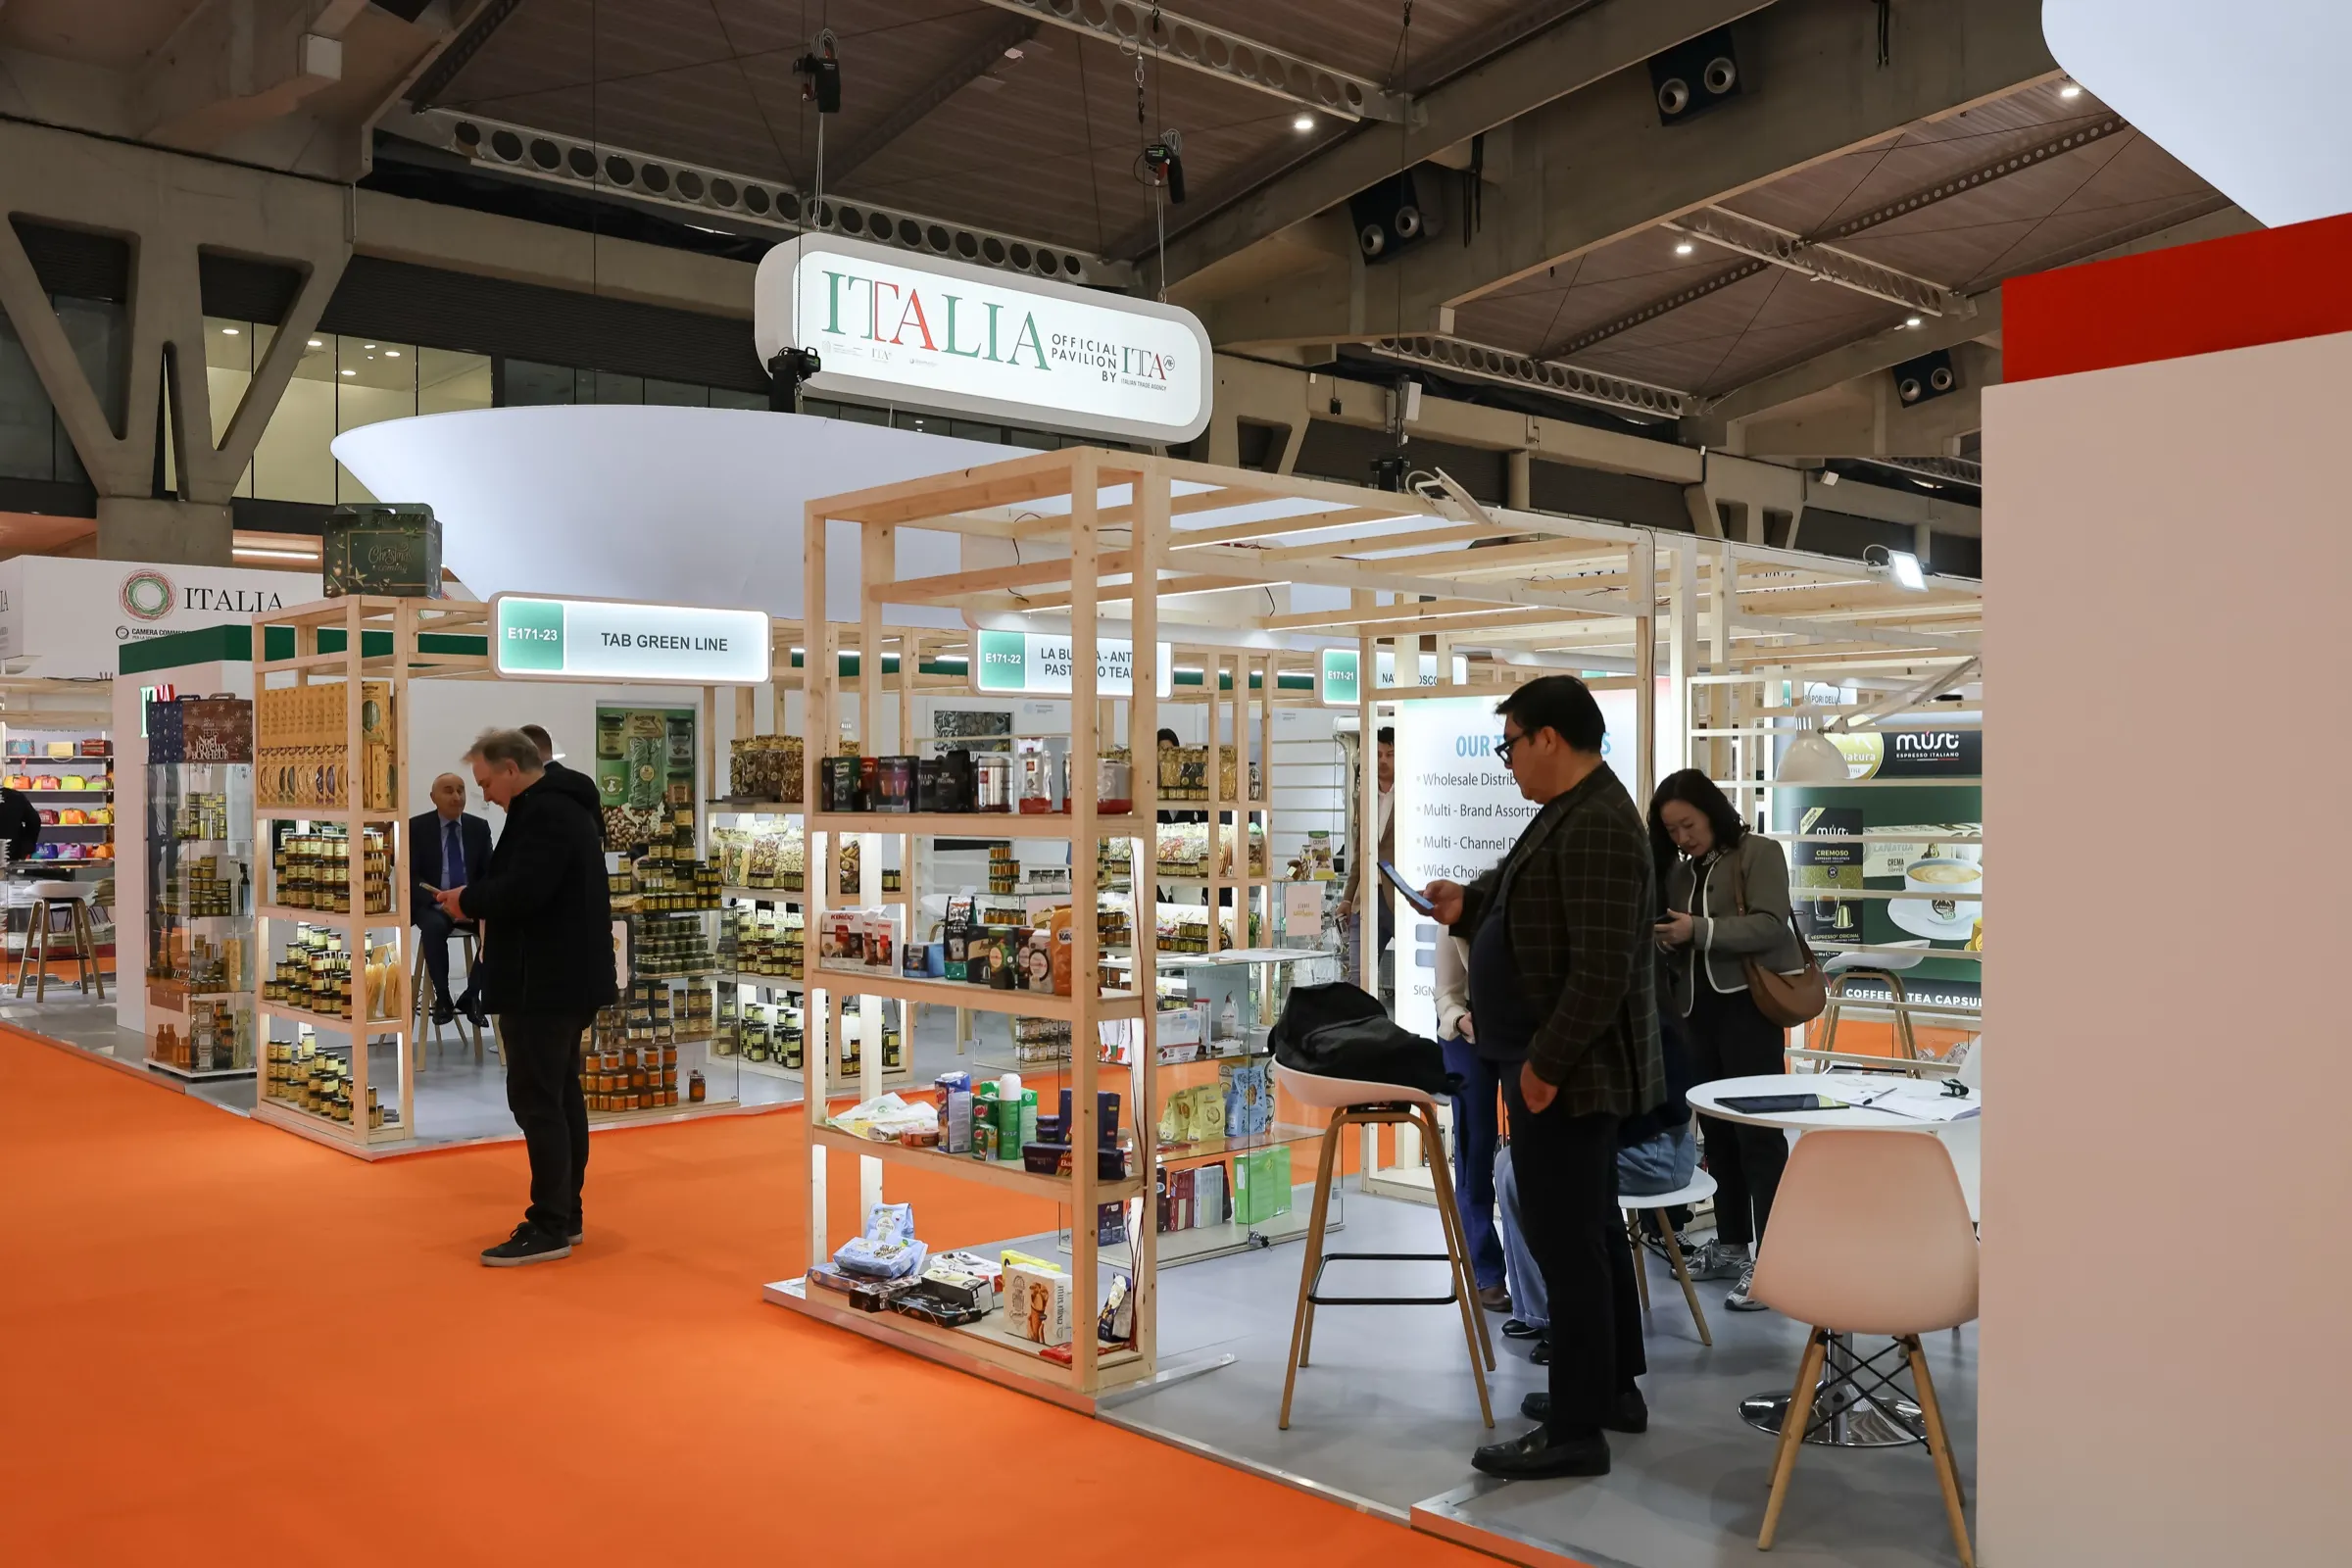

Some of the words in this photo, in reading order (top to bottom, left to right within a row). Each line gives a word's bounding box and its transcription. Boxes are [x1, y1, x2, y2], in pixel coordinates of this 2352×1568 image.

[822, 270, 1052, 370] ITALIA
[1052, 333, 1116, 356] OFFICIAL
[1052, 348, 1116, 369] PAVILION
[1121, 346, 1166, 380] ITA
[1102, 370, 1116, 383] BY
[1121, 378, 1137, 387] ITALIAN
[1138, 380, 1151, 389] TRADE
[1151, 383, 1167, 392] AGENCY
[184, 588, 282, 612] ITALIA
[508, 627, 558, 641] E171-23
[601, 632, 632, 647] TAB
[637, 635, 690, 650] GREEN
[695, 638, 728, 652] LINE
[985, 653, 1021, 664] E171-22
[1041, 648, 1055, 660] LA
[1110, 652, 1132, 662] ANT
[1327, 670, 1354, 681] E171-21
[1455, 735, 1491, 758] OUR
[1423, 772, 1479, 786] Wholesale
[1481, 772, 1517, 786] Distrib
[1423, 804, 1451, 816] Multi
[1460, 804, 1492, 817] Brand
[1495, 804, 1540, 817] Assortm
[1423, 835, 1451, 849] Multi
[1460, 836, 1505, 850] Channel
[1887, 858, 1904, 866] CREMA
[1423, 864, 1450, 877] Wide
[1453, 864, 1483, 878] Choic
[1845, 988, 1892, 1001] COFFEE
[1907, 993, 1932, 1004] TEA
[1935, 995, 1982, 1007] CAPSUL
